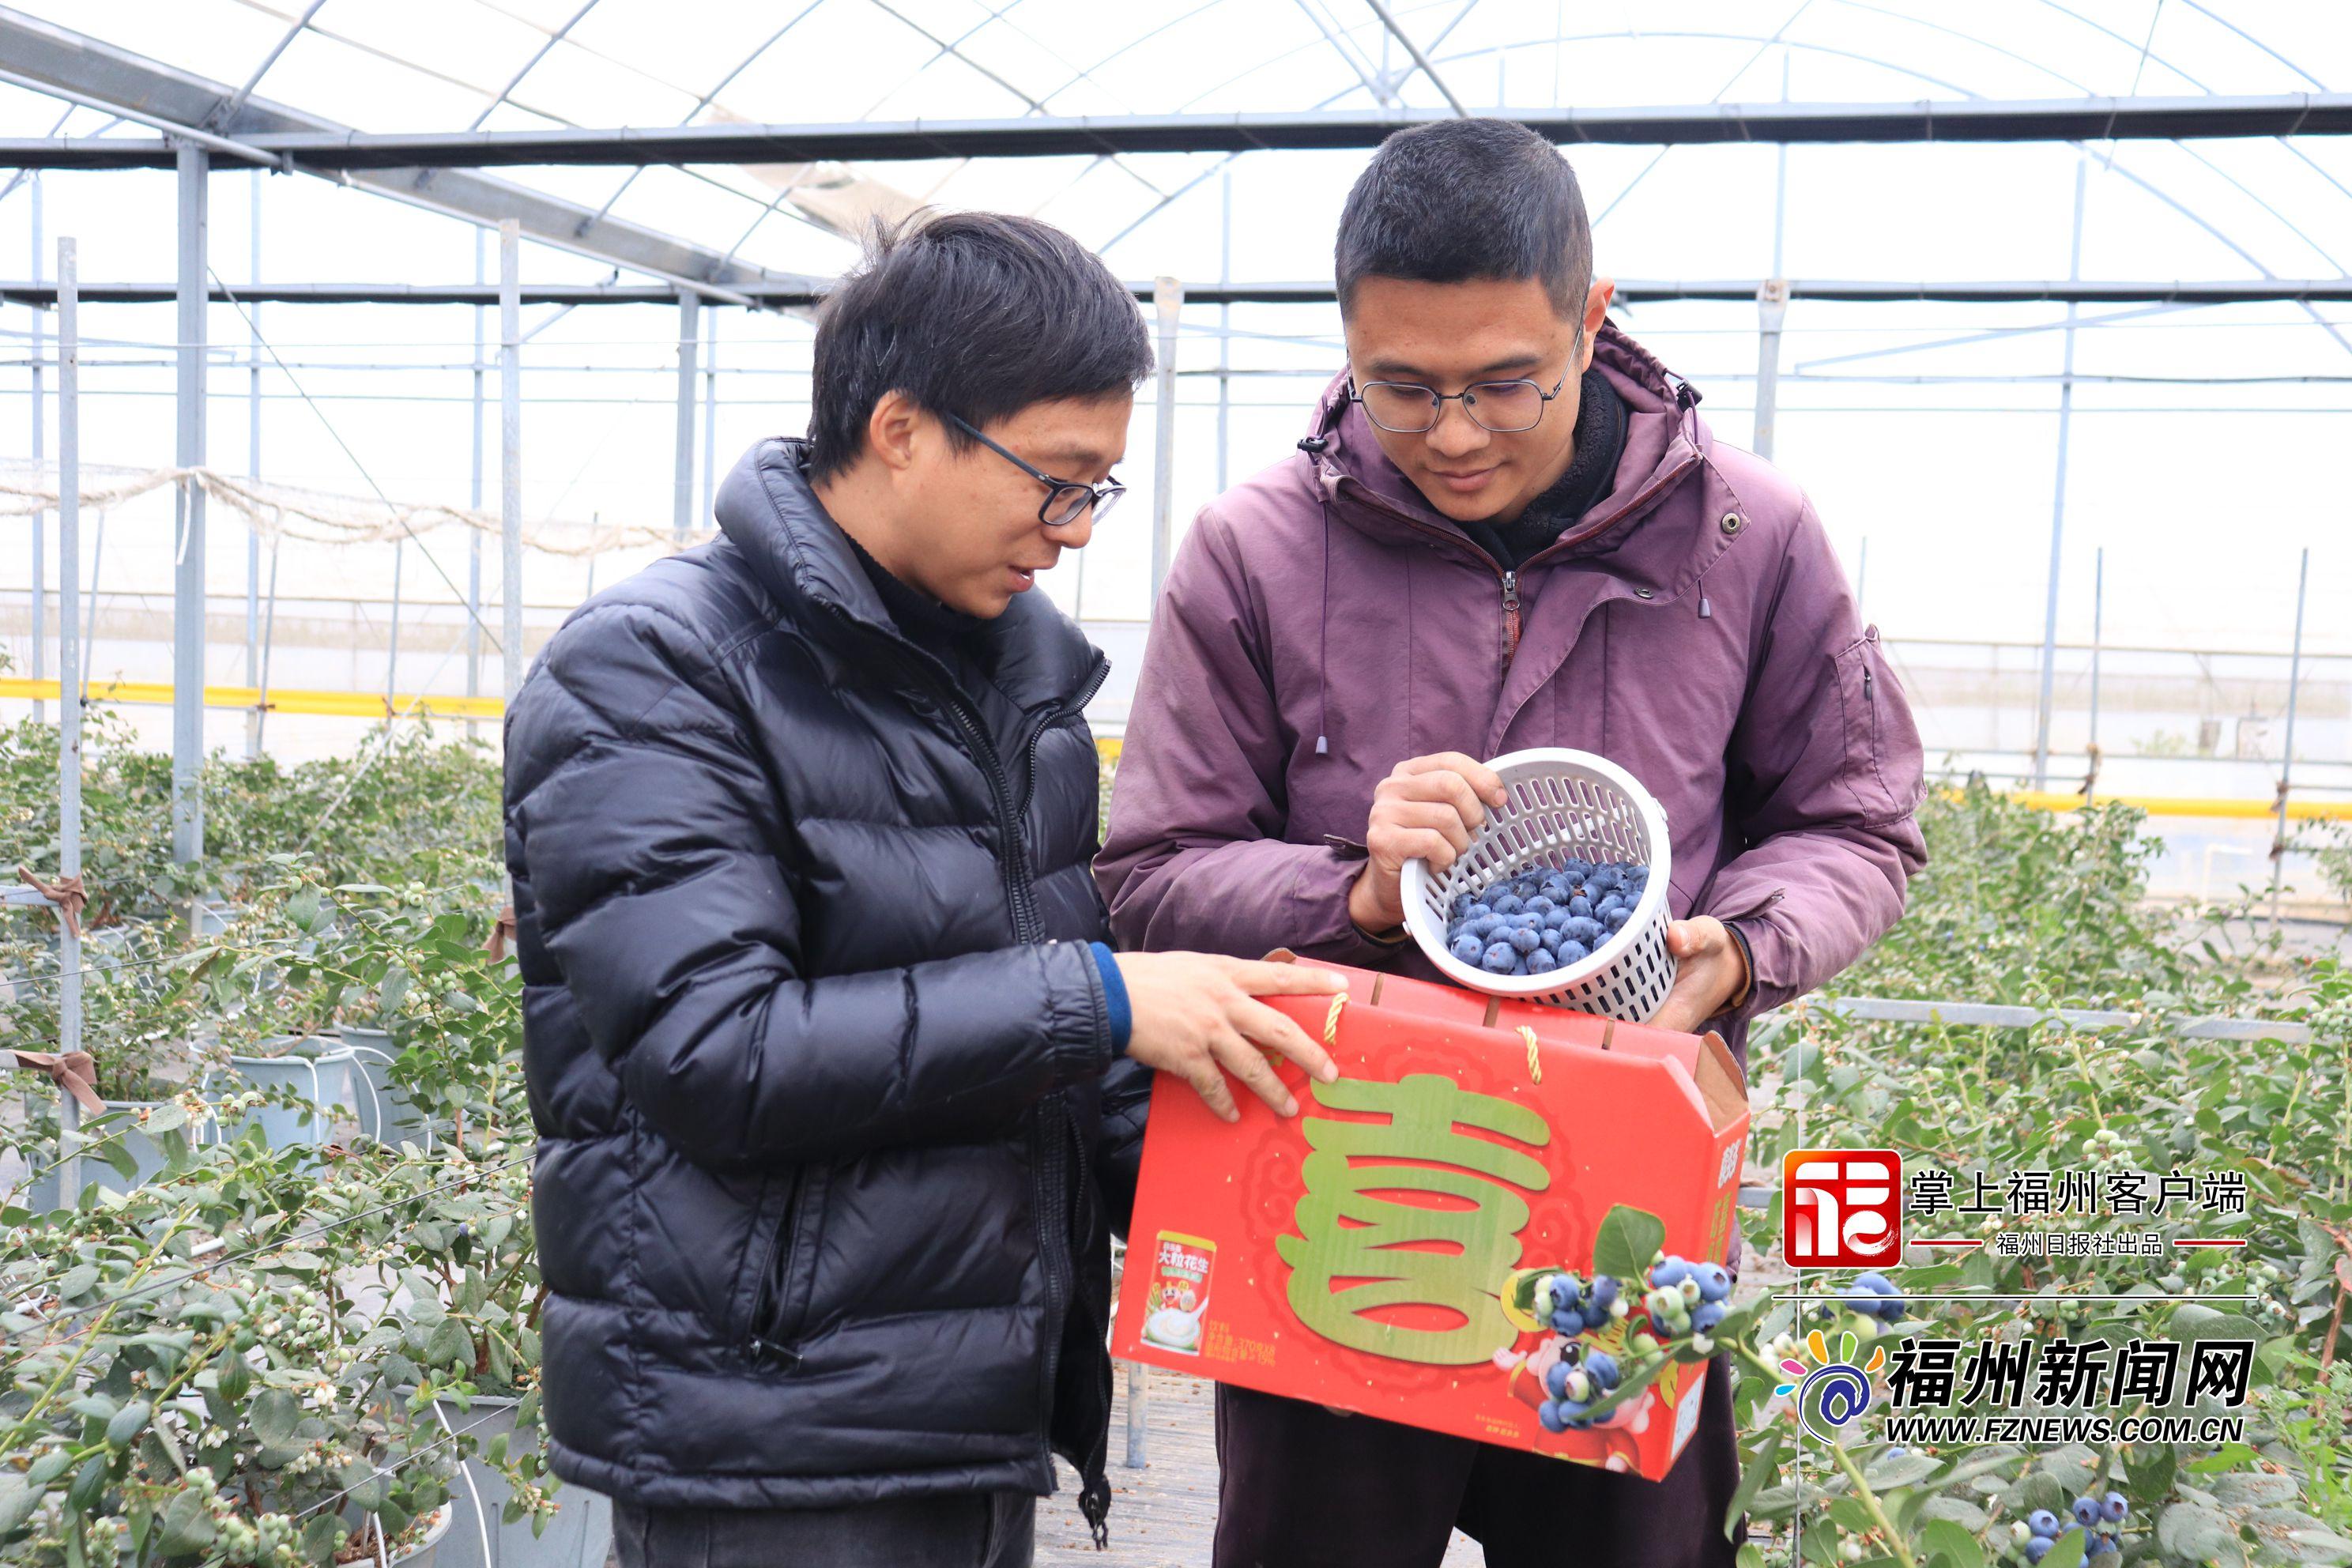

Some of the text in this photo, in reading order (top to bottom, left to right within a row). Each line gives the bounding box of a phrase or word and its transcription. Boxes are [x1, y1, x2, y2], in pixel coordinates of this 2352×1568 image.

[1158, 1251, 1209, 1274] 大粒花生
[1276, 1074, 1551, 1365] 喜
